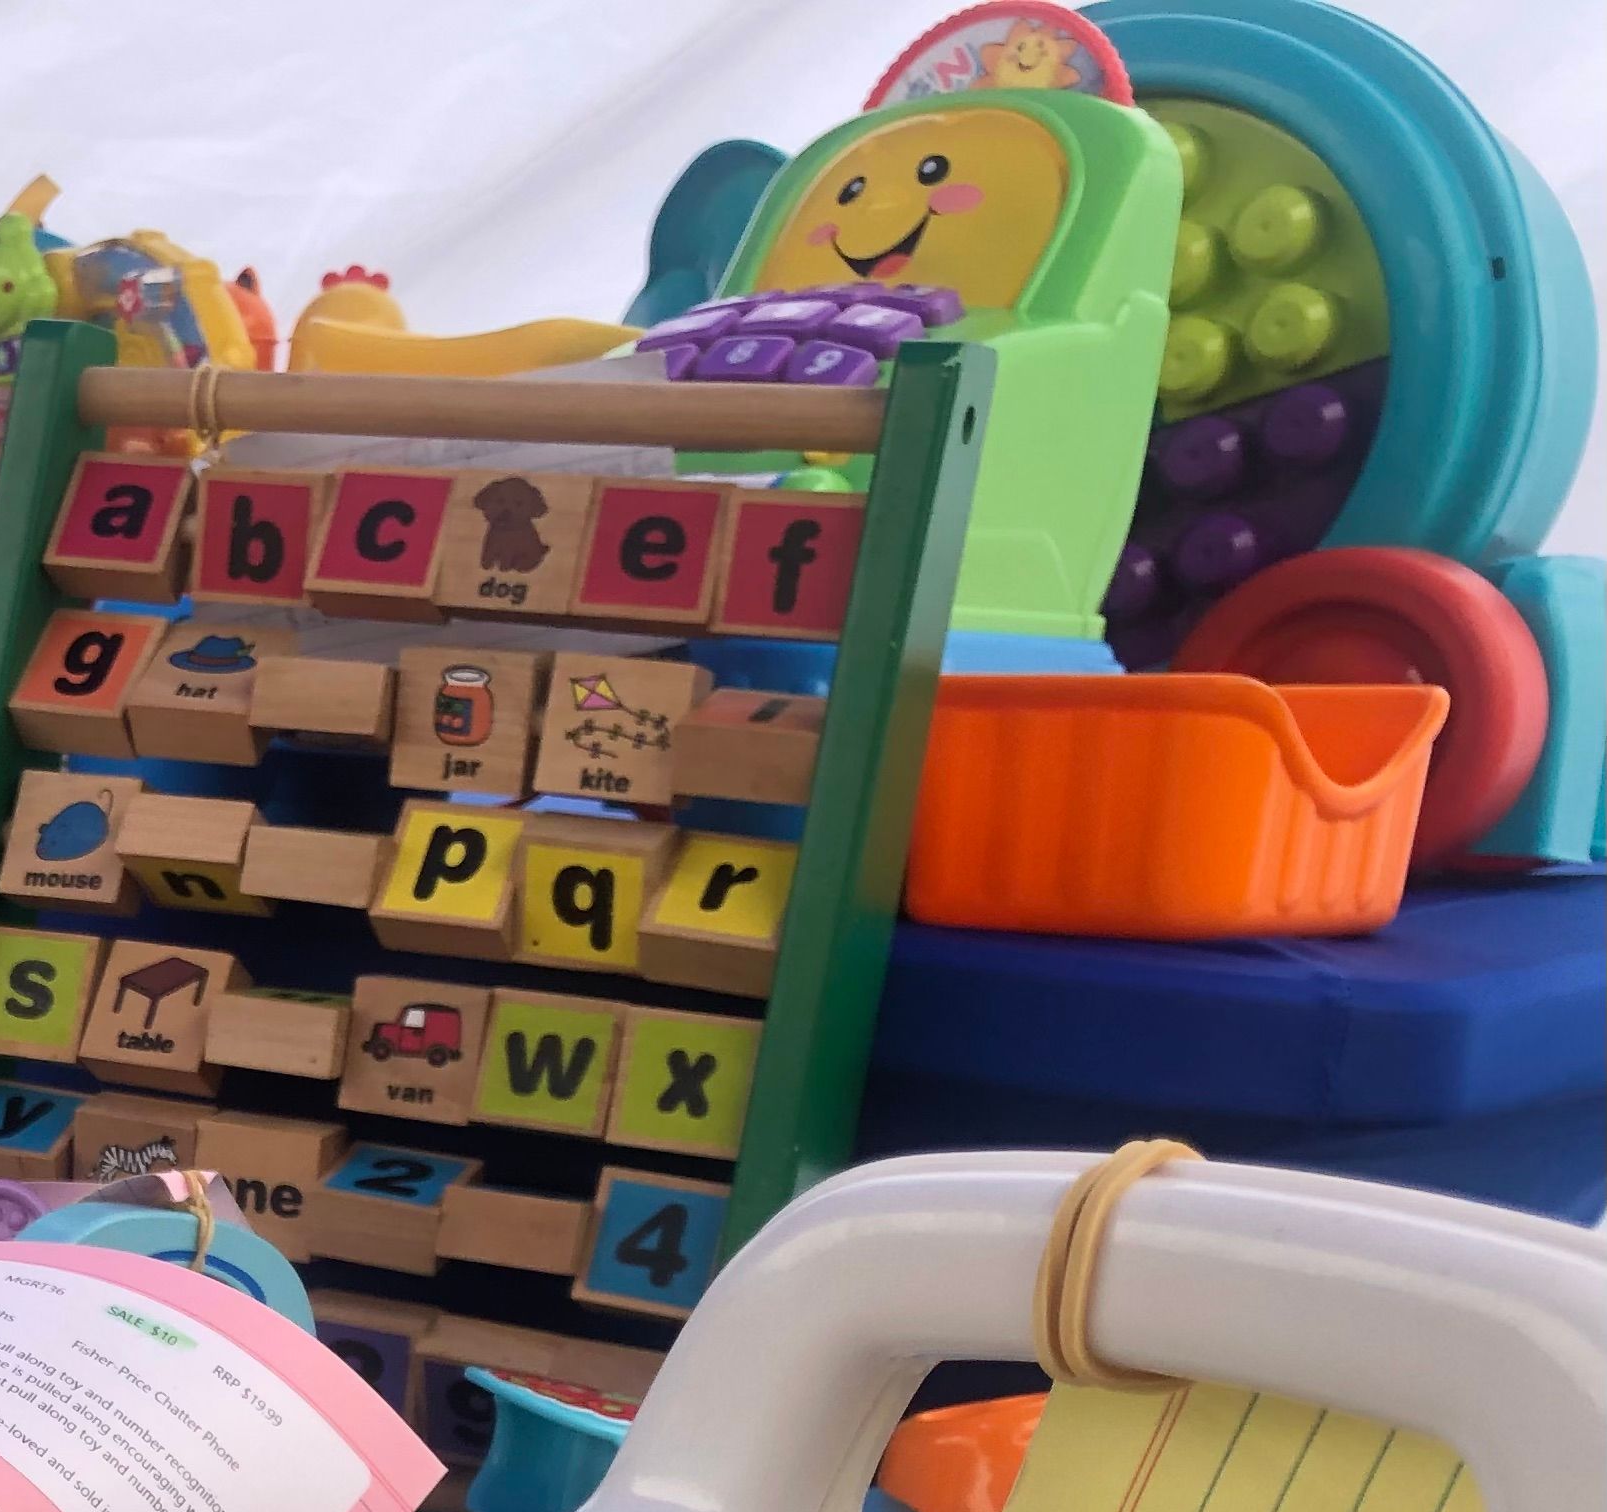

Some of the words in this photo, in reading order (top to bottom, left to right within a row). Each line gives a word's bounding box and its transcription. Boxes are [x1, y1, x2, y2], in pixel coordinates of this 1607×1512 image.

[804, 349, 843, 376] 9
[91, 484, 154, 540] a
[227, 495, 284, 583] b
[355, 500, 416, 562] c
[478, 576, 528, 605] dog
[619, 515, 686, 582] e
[769, 519, 822, 615] f
[54, 630, 124, 696] g
[175, 681, 218, 701] hat
[443, 754, 481, 780] jar
[579, 767, 630, 795] kite
[24, 870, 102, 892] mouse
[413, 824, 488, 900] p
[553, 865, 616, 951] q
[699, 862, 761, 911] r
[117, 1030, 176, 1054] table
[386, 1083, 434, 1105] van
[505, 1031, 596, 1100] w
[656, 1050, 718, 1119] x
[223, 1176, 303, 1218] ne
[353, 1159, 435, 1198] 2
[616, 1204, 689, 1288] 4
[5, 1274, 66, 1297] MGRT36
[107, 1305, 144, 1330] SALE
[150, 1326, 178, 1347] $10
[6, 1381, 38, 1405] pull
[37, 1400, 78, 1434] along
[79, 1430, 103, 1452] toy
[101, 1451, 130, 1476] and
[12, 1364, 25, 1377] is
[24, 1373, 73, 1405] pulled
[72, 1400, 112, 1436] along
[112, 1433, 187, 1508] encouraging
[16, 1347, 57, 1377] along
[59, 1370, 85, 1392] toy
[84, 1388, 114, 1411] and
[113, 1408, 166, 1453] number
[71, 1340, 152, 1394] Fisher-Price
[154, 1390, 203, 1434] Chatter
[201, 1430, 241, 1473] Phone
[212, 1364, 241, 1388] RRP
[241, 1387, 283, 1428] $19.99
[47, 1457, 76, 1482] and
[73, 1480, 104, 1509] sold
